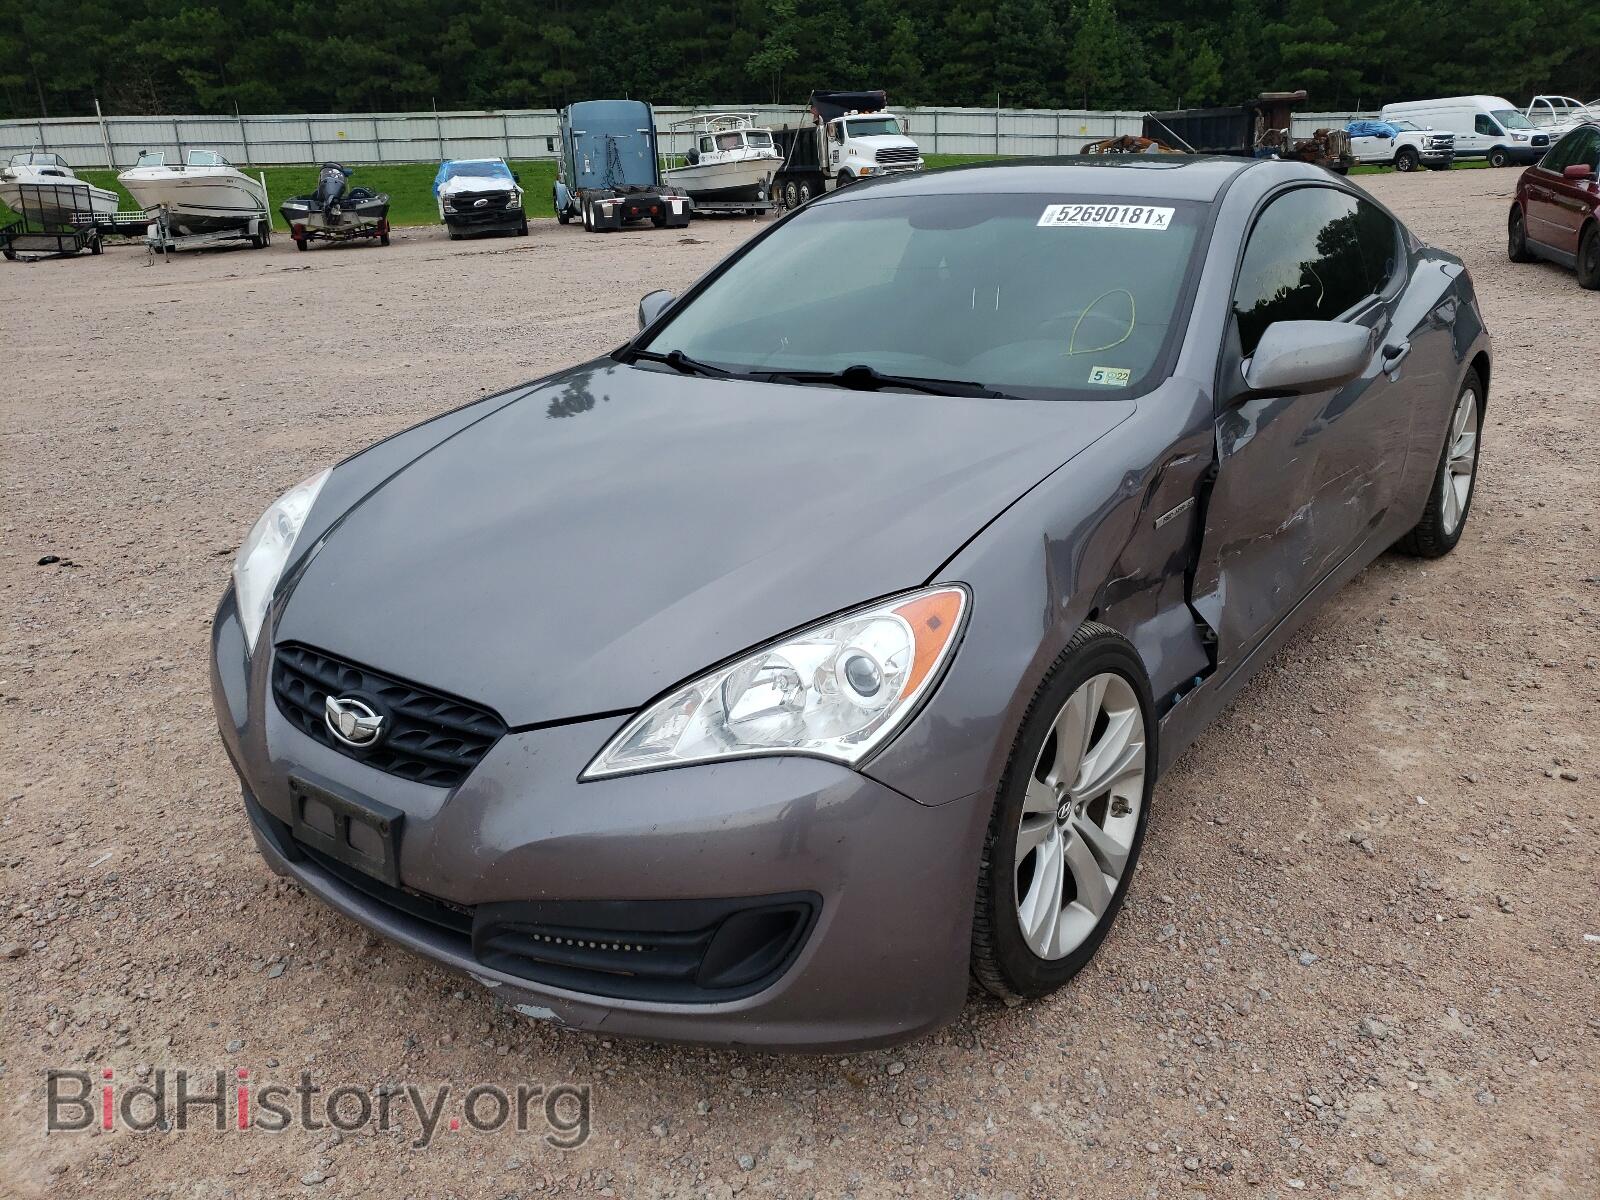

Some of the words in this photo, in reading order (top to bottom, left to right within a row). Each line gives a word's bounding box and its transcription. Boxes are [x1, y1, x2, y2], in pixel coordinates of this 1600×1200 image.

[1056, 205, 1154, 224] 52690181
[1093, 370, 1104, 381] 5
[1116, 372, 1128, 381] 22
